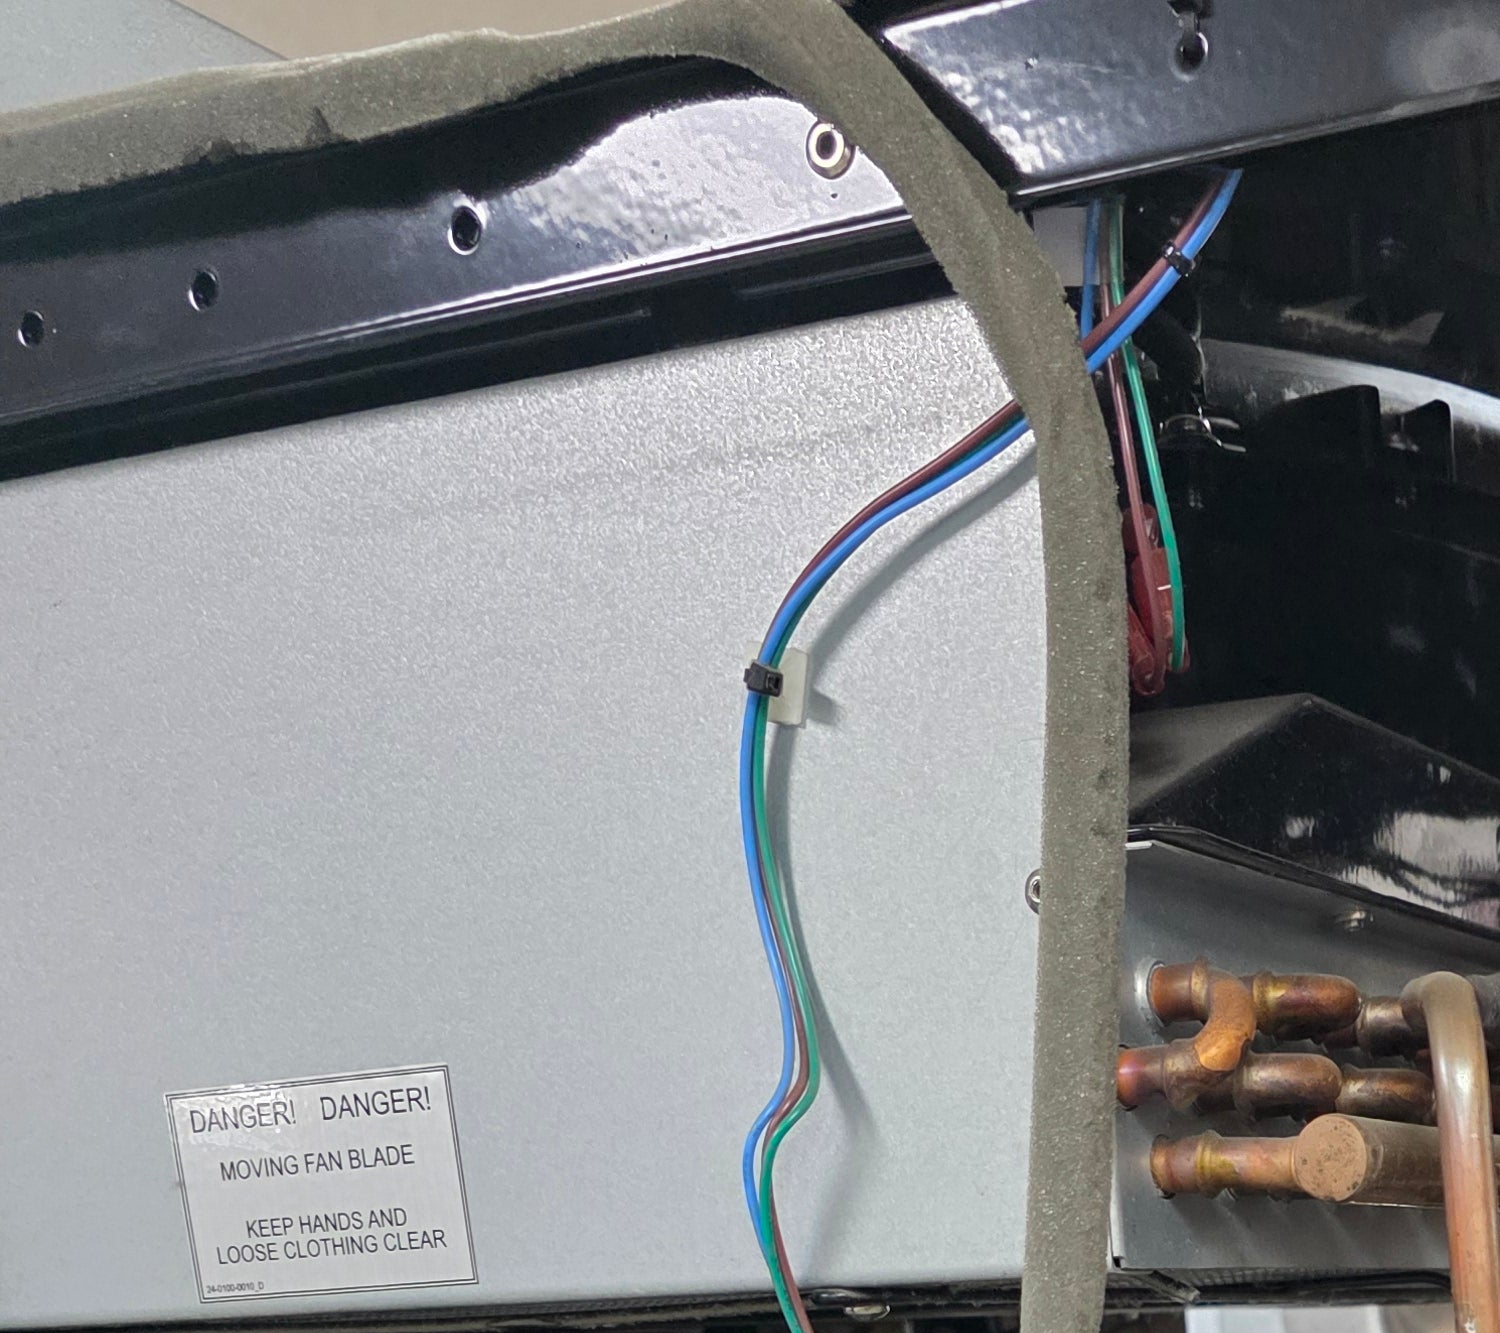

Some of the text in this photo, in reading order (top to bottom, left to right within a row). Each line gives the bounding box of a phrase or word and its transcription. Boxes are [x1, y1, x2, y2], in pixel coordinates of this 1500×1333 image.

[190, 1086, 432, 1135] DANGER! DANGER!
[219, 1144, 415, 1181] MOVING FAN BLADE
[246, 1207, 408, 1239] KEEP HANDS AND
[216, 1229, 448, 1265] LOOSE CLOTHING CLEAR
